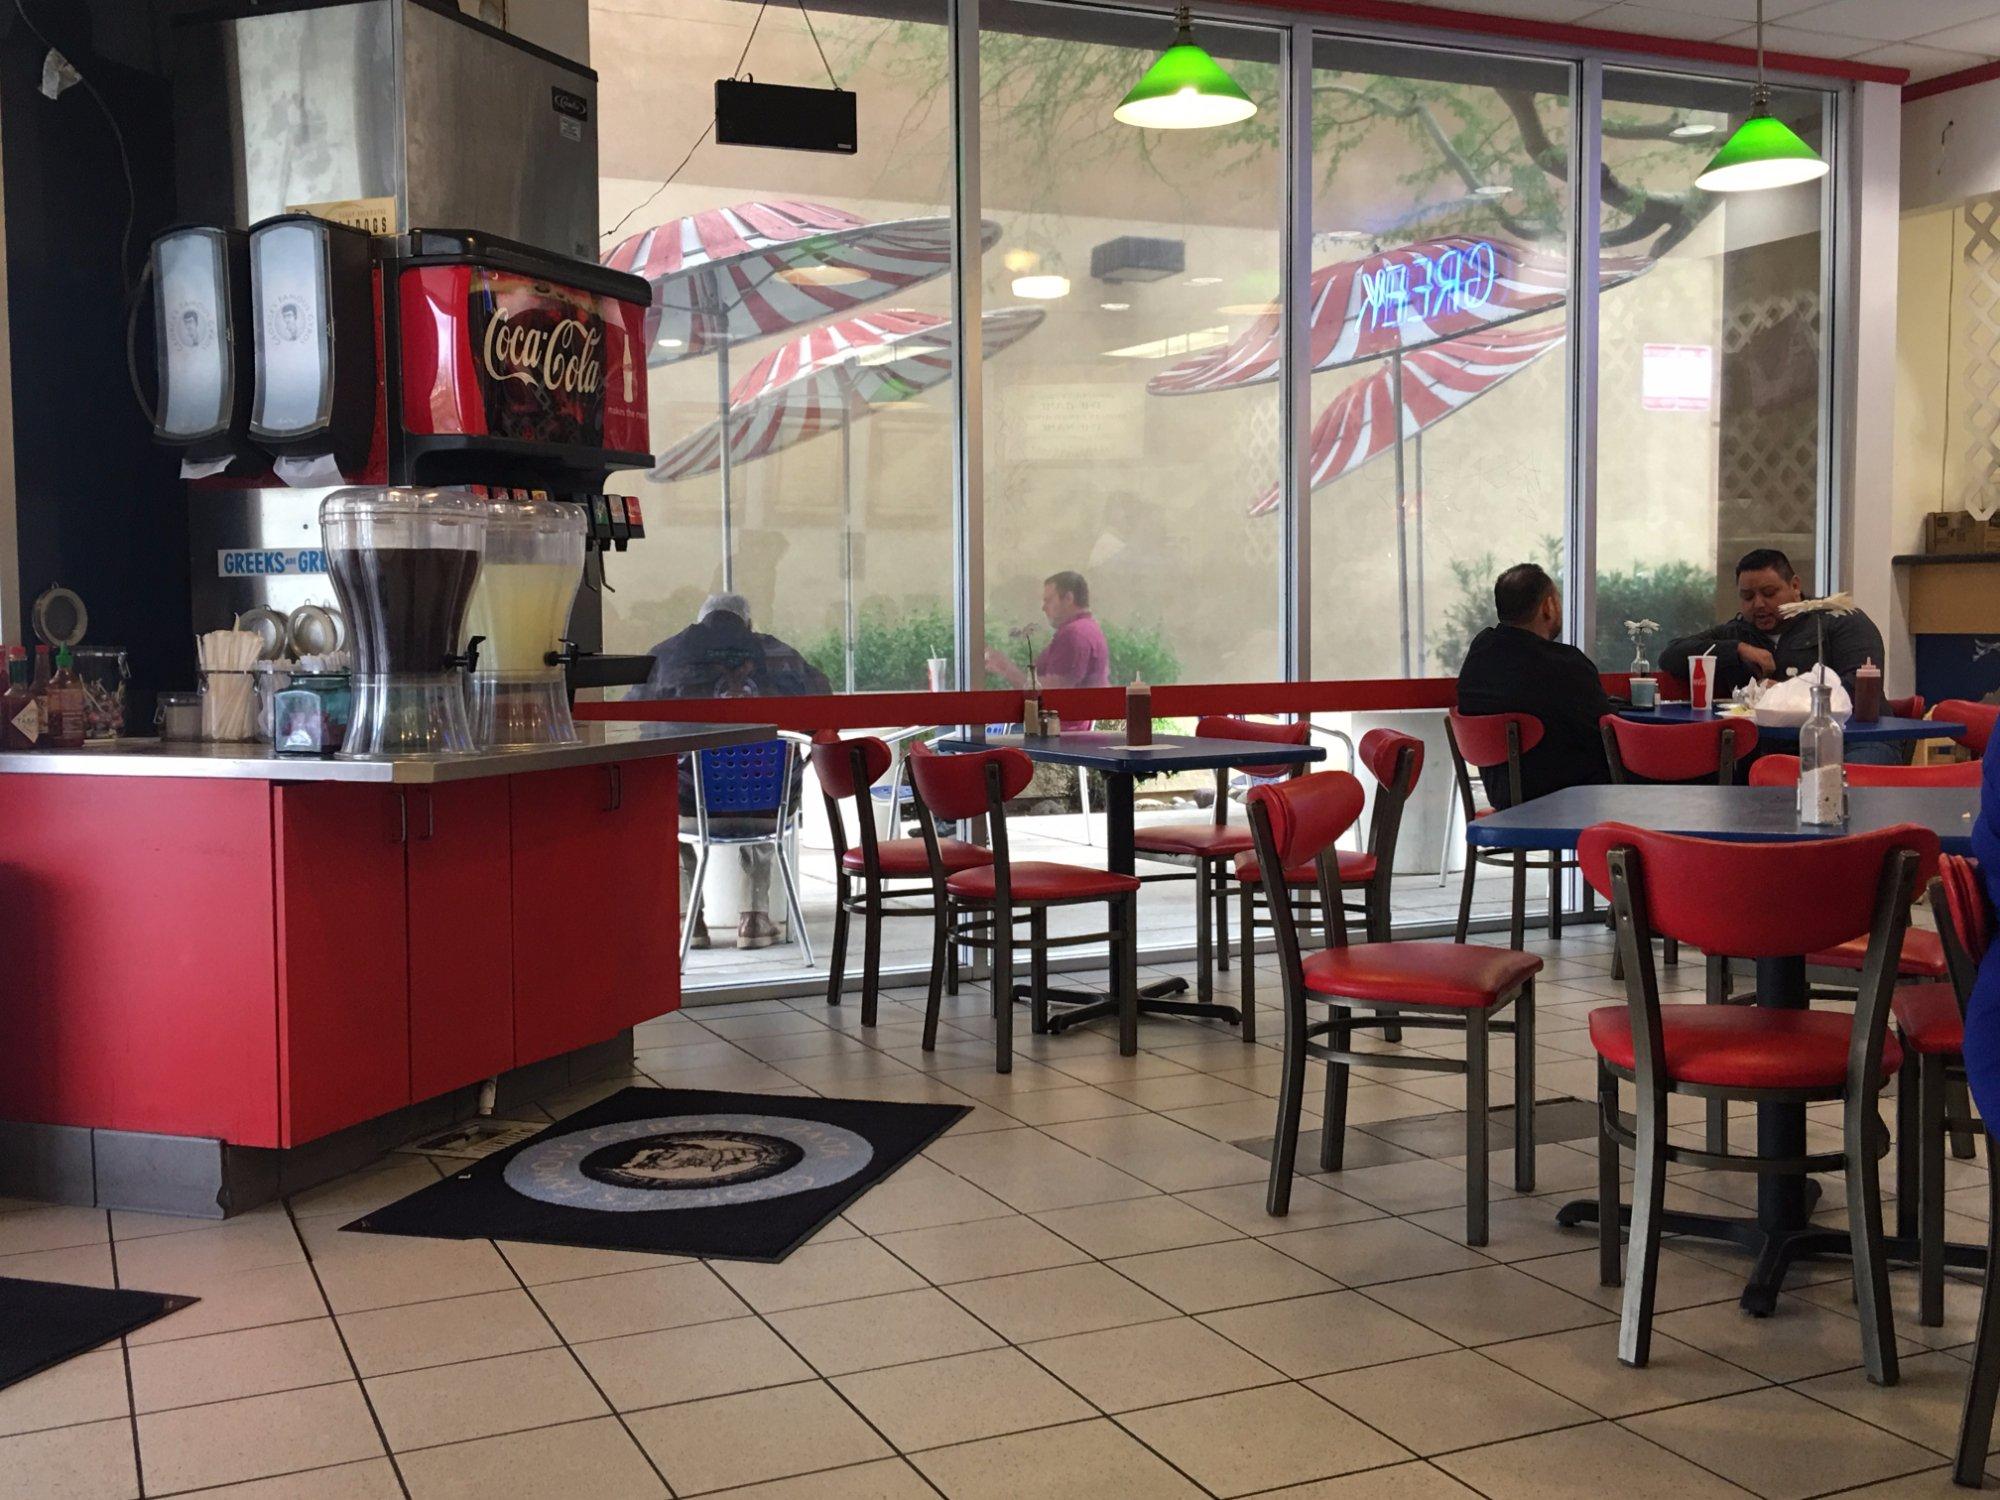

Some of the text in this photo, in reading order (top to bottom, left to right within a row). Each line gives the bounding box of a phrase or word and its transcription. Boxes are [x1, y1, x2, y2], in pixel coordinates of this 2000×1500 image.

[483, 306, 601, 394] Coca-Cola
[223, 552, 285, 574] GREEKS
[298, 550, 328, 573] GRE
